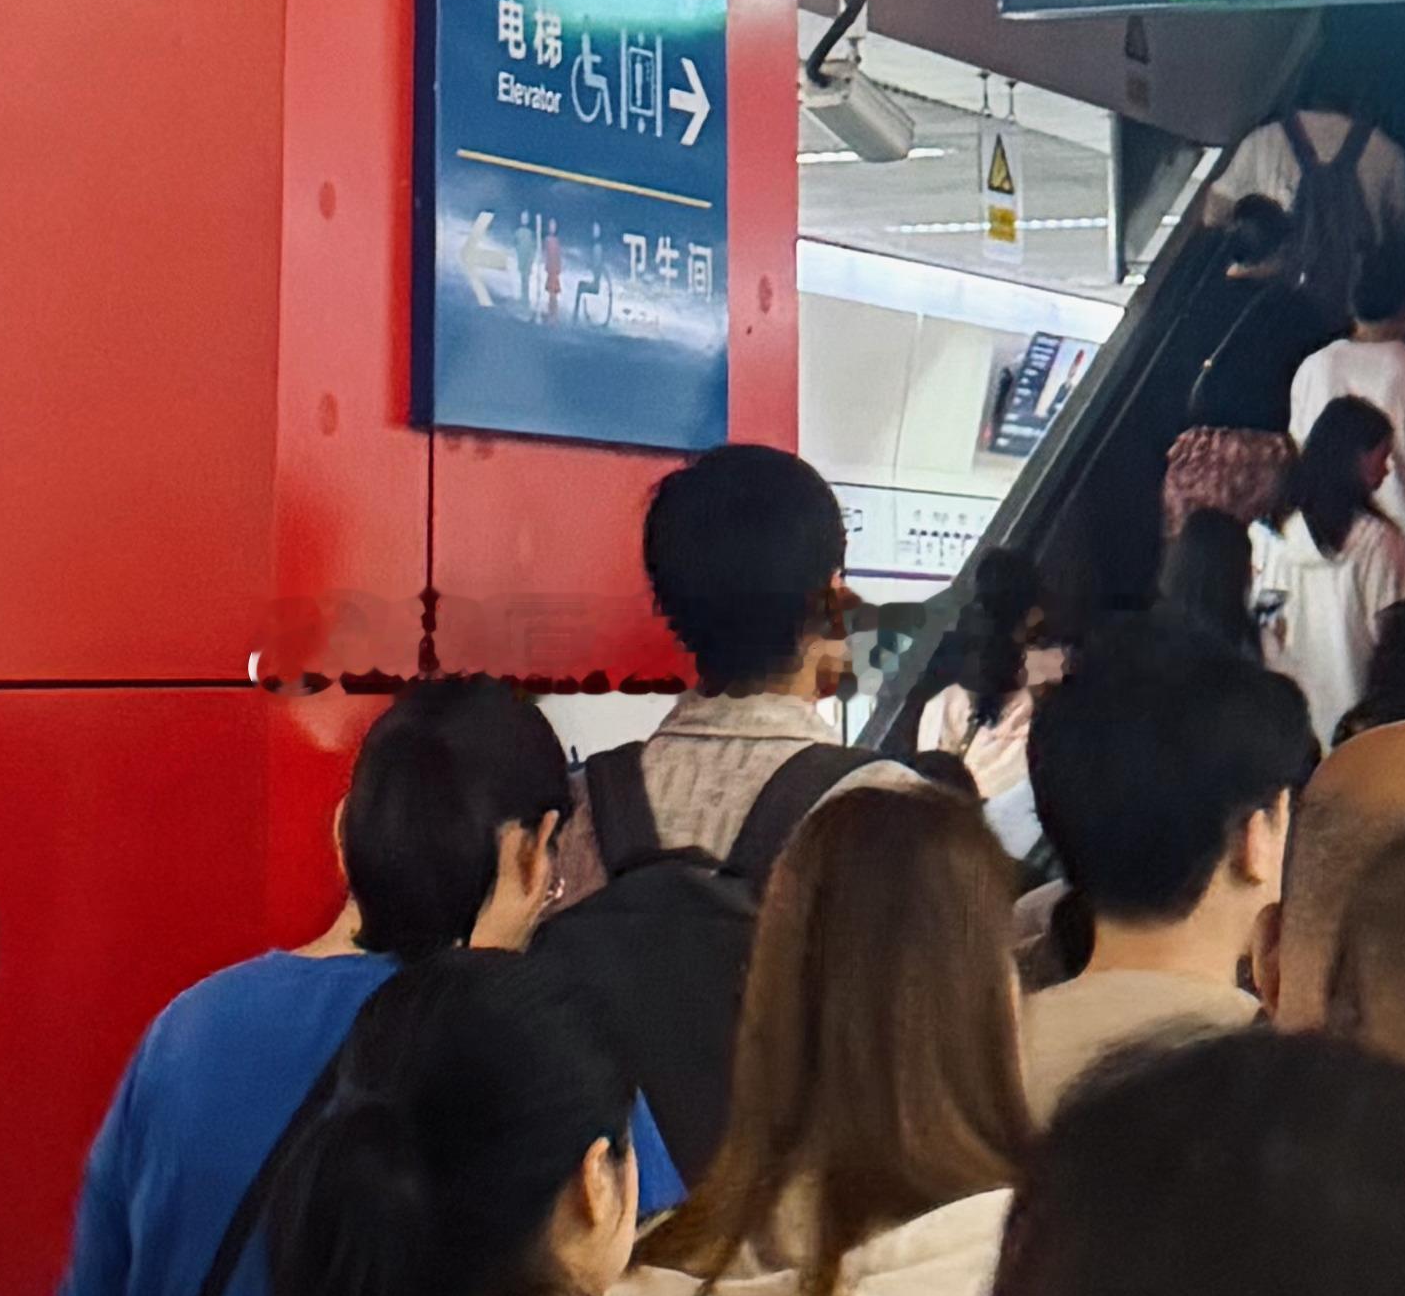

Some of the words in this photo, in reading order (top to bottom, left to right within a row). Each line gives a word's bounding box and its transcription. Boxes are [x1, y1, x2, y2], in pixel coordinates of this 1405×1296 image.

[497, 71, 563, 115] Elevator
[622, 231, 714, 302] 卫生间
